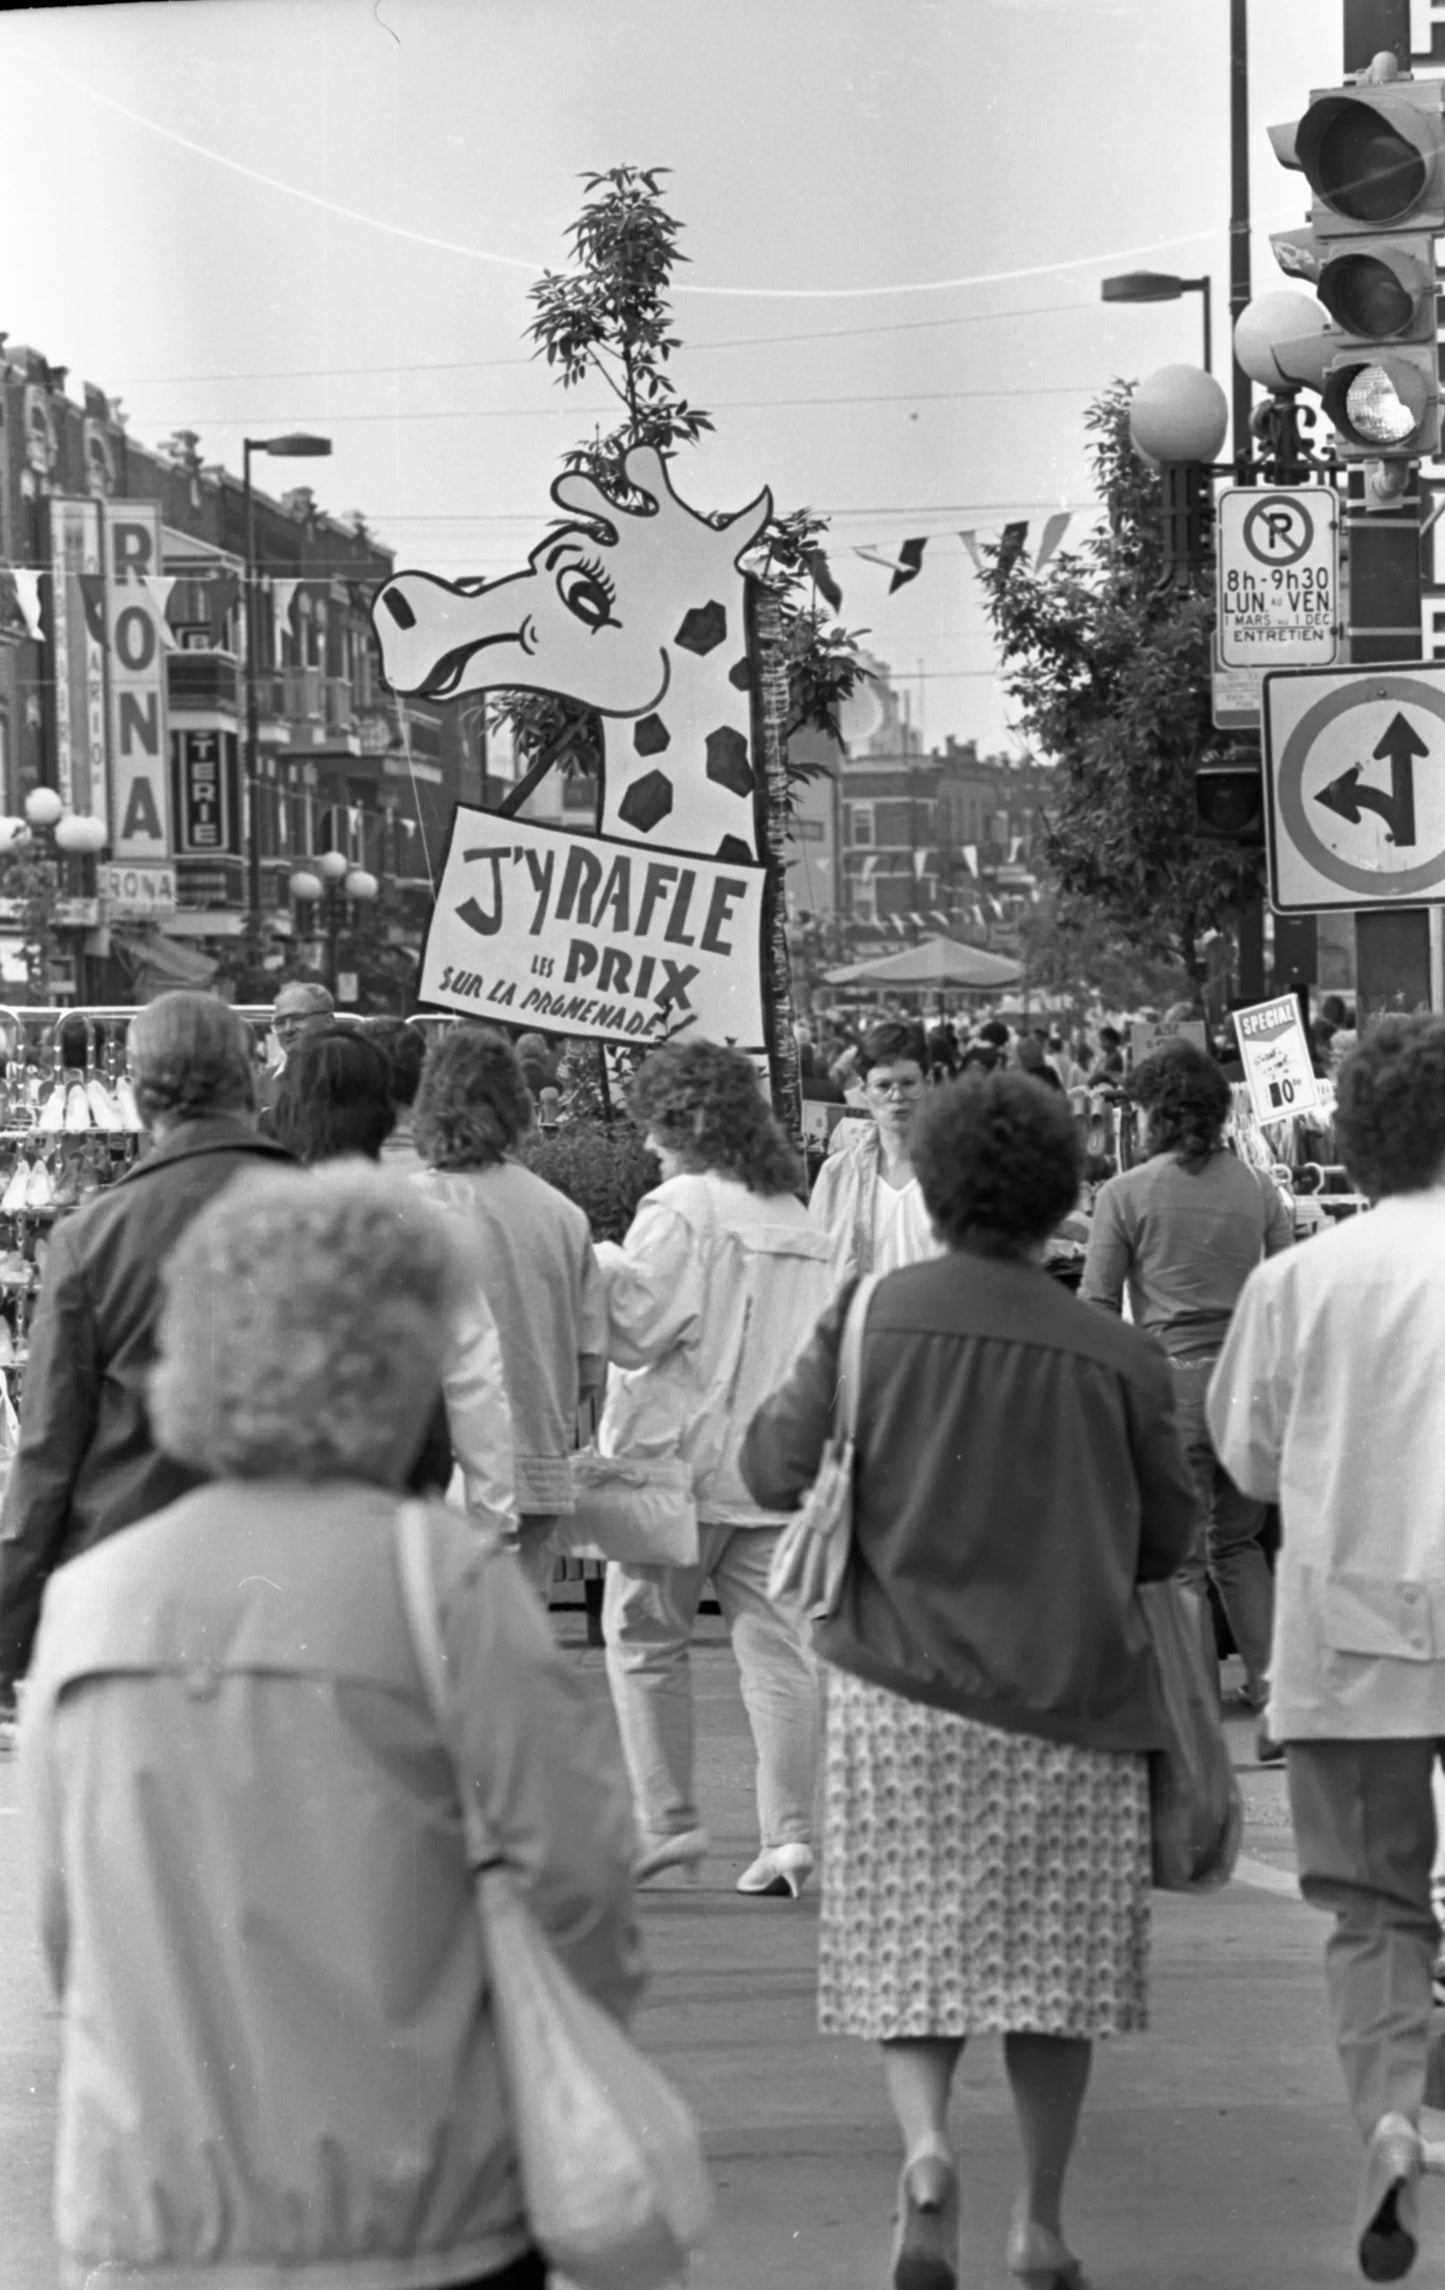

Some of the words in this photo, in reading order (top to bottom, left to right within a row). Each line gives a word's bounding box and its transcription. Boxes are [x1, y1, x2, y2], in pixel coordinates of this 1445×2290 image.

[1233, 629, 1324, 642] ENTRETIEN
[1235, 614, 1272, 626] MARS
[112, 522, 163, 840] RONA
[110, 871, 173, 900] RONA
[531, 954, 555, 979] LES
[563, 938, 701, 1011] PRIX
[438, 966, 484, 999] SUR
[487, 978, 517, 1006] LA
[519, 987, 660, 1036] PROMENADE
[1241, 1003, 1295, 1036] SPECIAL
